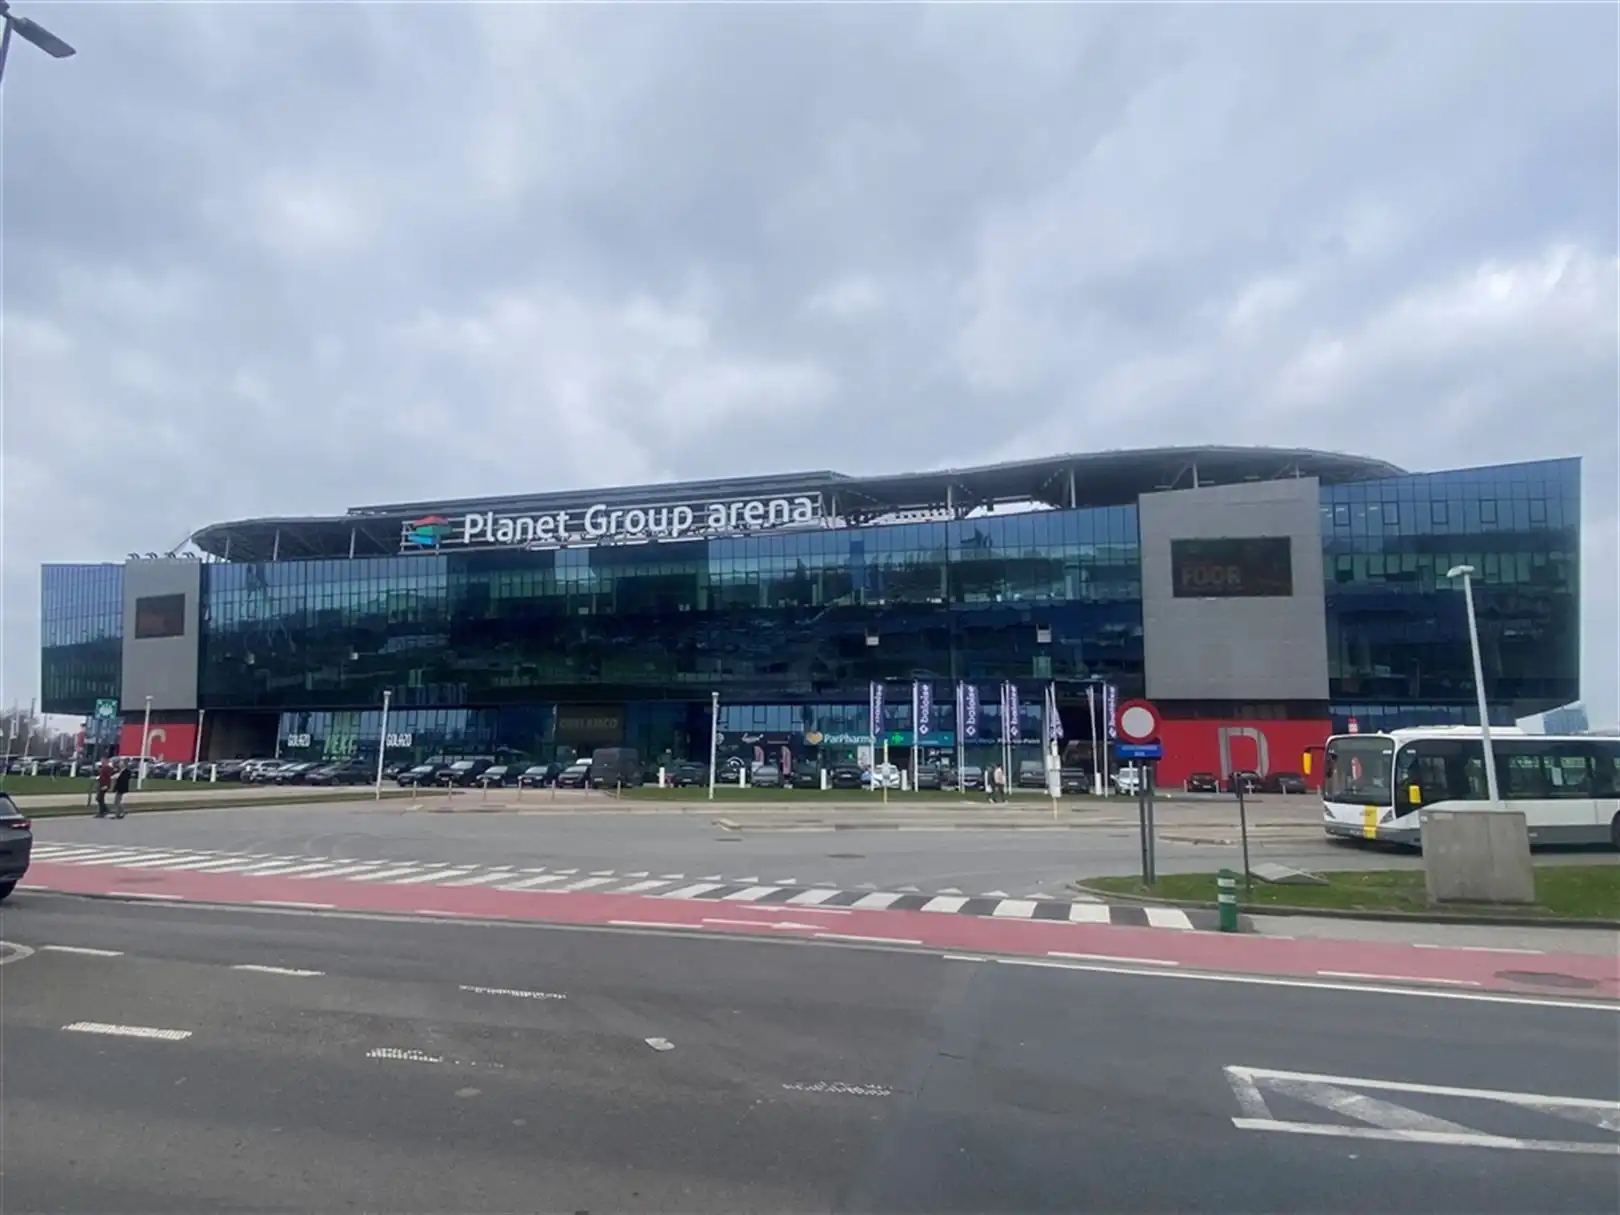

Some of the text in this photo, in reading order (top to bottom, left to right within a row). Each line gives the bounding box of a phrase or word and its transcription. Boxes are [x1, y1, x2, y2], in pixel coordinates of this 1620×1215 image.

[463, 496, 813, 544] Planet Group arena
[920, 684, 930, 723] baloise
[965, 685, 976, 725] baloise
[1218, 727, 1270, 781] D
